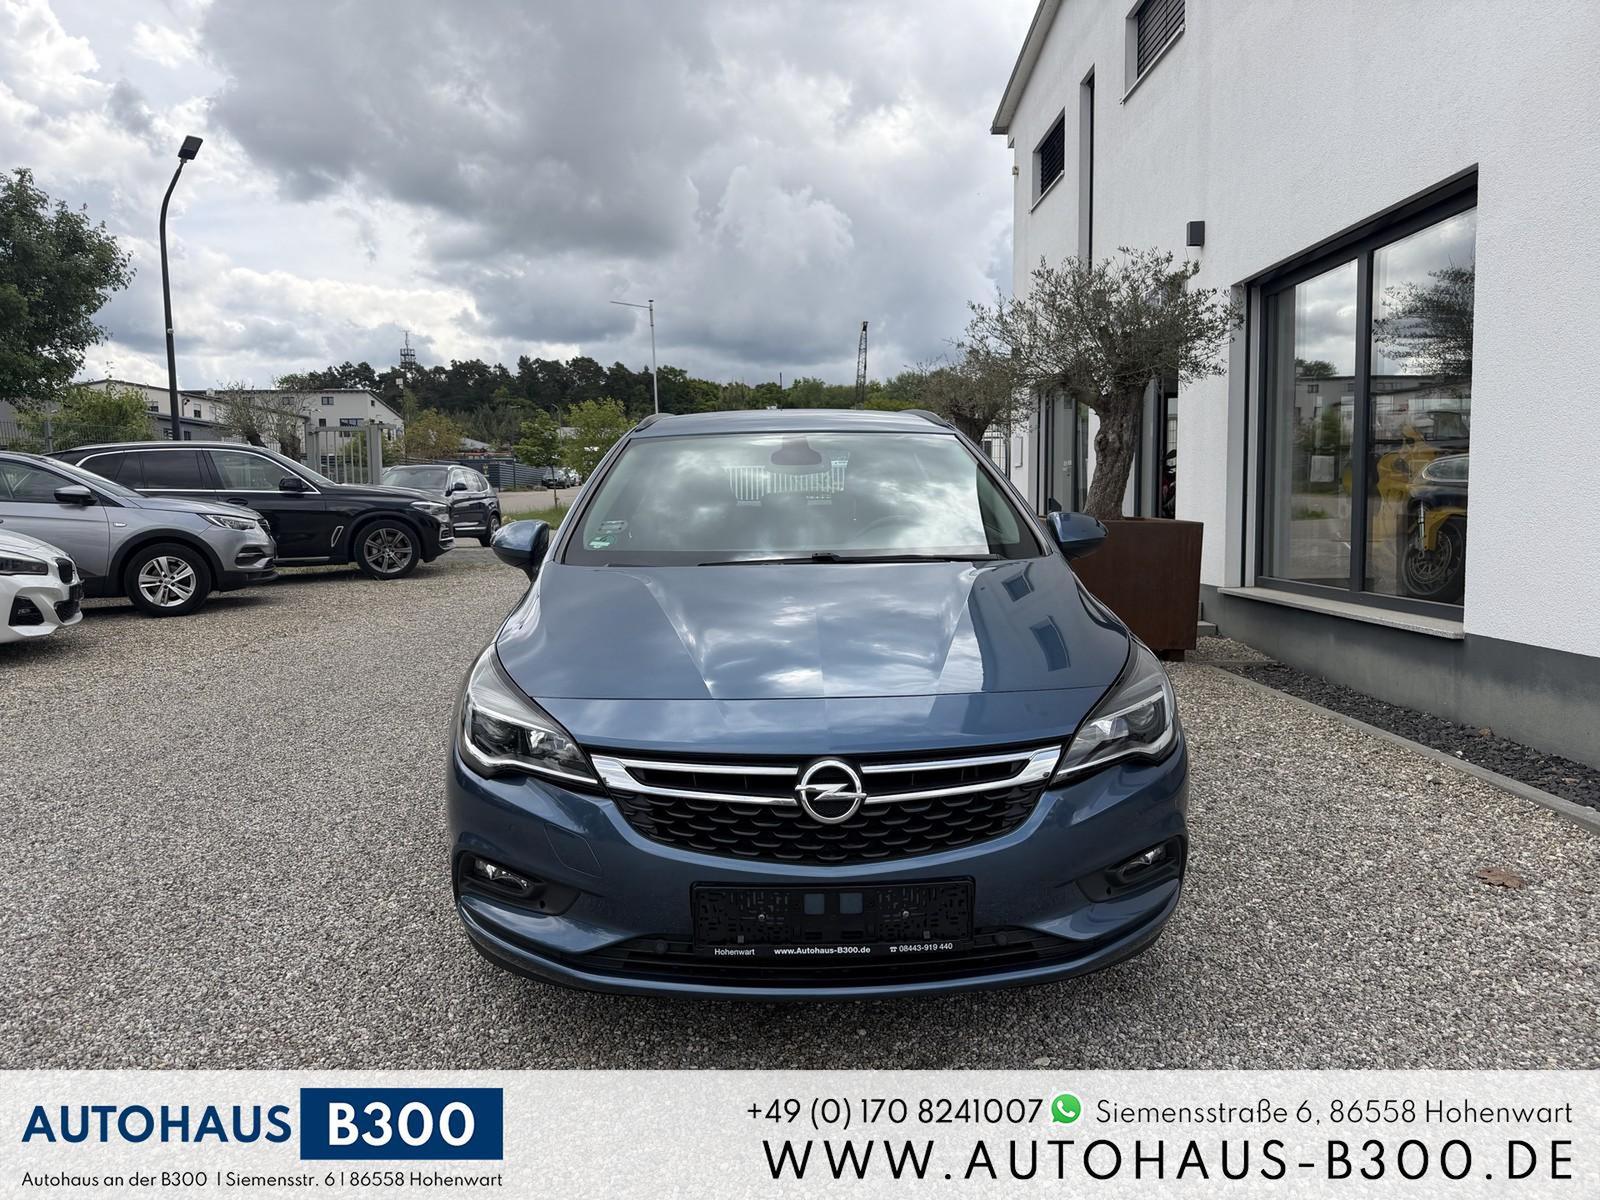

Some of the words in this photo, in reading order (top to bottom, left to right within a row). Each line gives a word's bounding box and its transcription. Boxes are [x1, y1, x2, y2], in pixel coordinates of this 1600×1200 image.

[714, 947, 756, 957] Hohenwart
[773, 946, 872, 956] www.Autohaus-B300.de
[898, 944, 938, 953] 08443-919
[939, 943, 954, 951] 440
